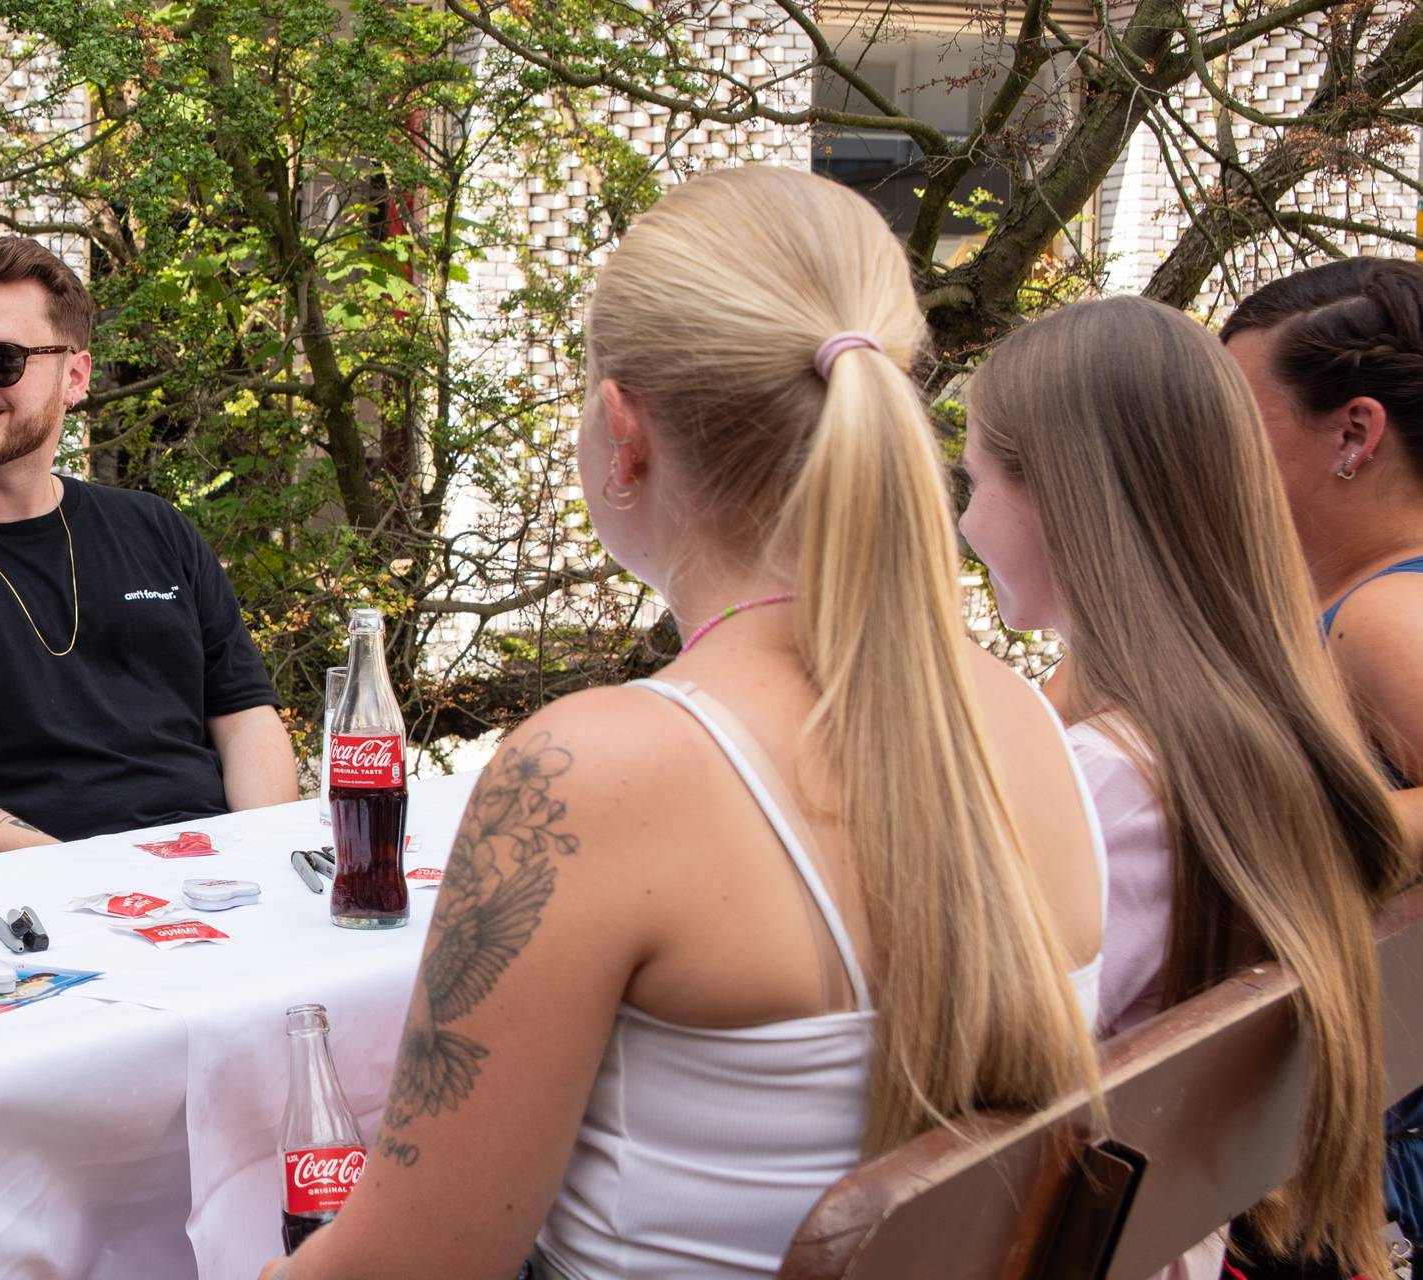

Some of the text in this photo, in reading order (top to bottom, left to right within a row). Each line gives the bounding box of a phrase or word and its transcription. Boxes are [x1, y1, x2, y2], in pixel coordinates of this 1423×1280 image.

[331, 738, 394, 767] Coca-Cola
[294, 1151, 368, 1188] Coca-Co
[308, 1186, 348, 1195] ORIGINAL
